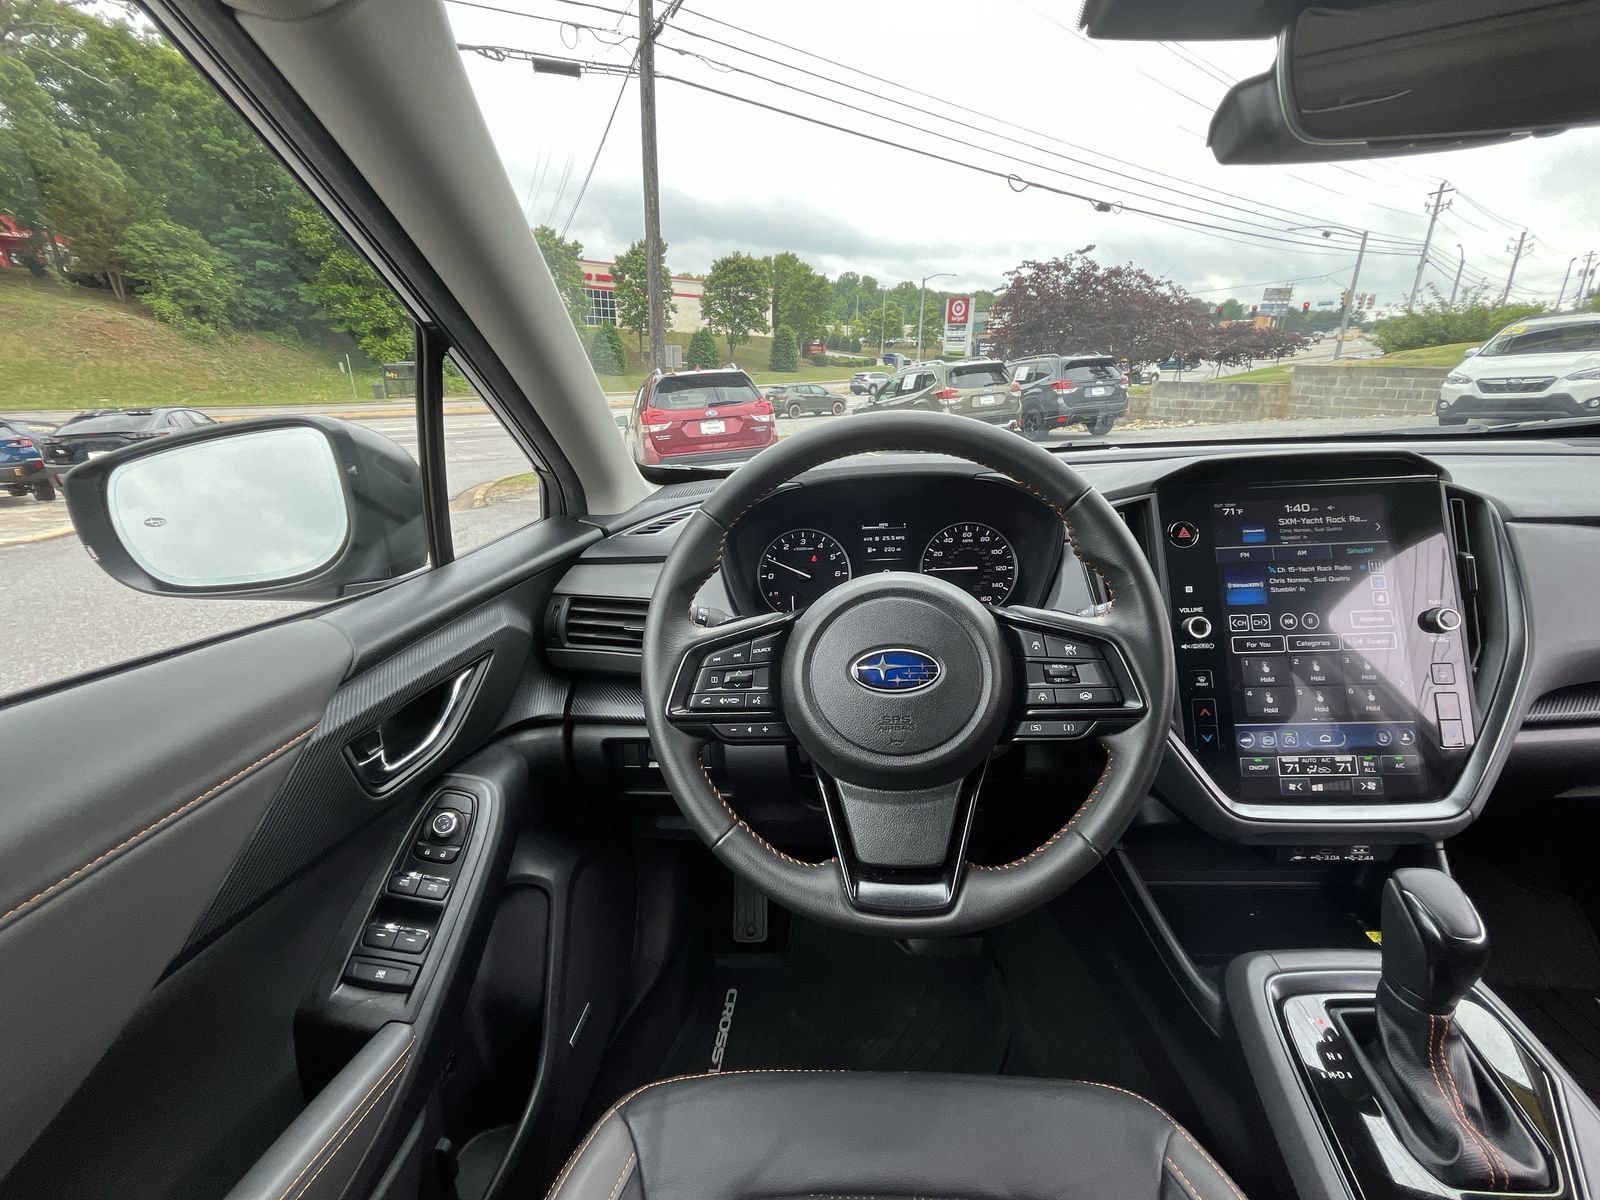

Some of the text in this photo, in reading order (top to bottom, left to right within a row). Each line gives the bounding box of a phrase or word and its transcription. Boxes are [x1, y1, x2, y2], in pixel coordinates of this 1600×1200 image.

[1285, 503, 1311, 513] 1:40
[1278, 517, 1323, 526] SXM-Yacht
[1326, 515, 1346, 524] Rock
[1346, 546, 1374, 554] SiriusXM
[1296, 639, 1331, 648] Categories
[1361, 673, 1377, 681] Hold
[1314, 705, 1330, 713] Hold
[1365, 704, 1381, 712] Hold
[882, 715, 912, 724] SRS
[877, 724, 916, 732] AIRBAG
[1285, 763, 1300, 773] 71
[1336, 762, 1352, 772] 71
[1326, 1052, 1336, 1061] N
